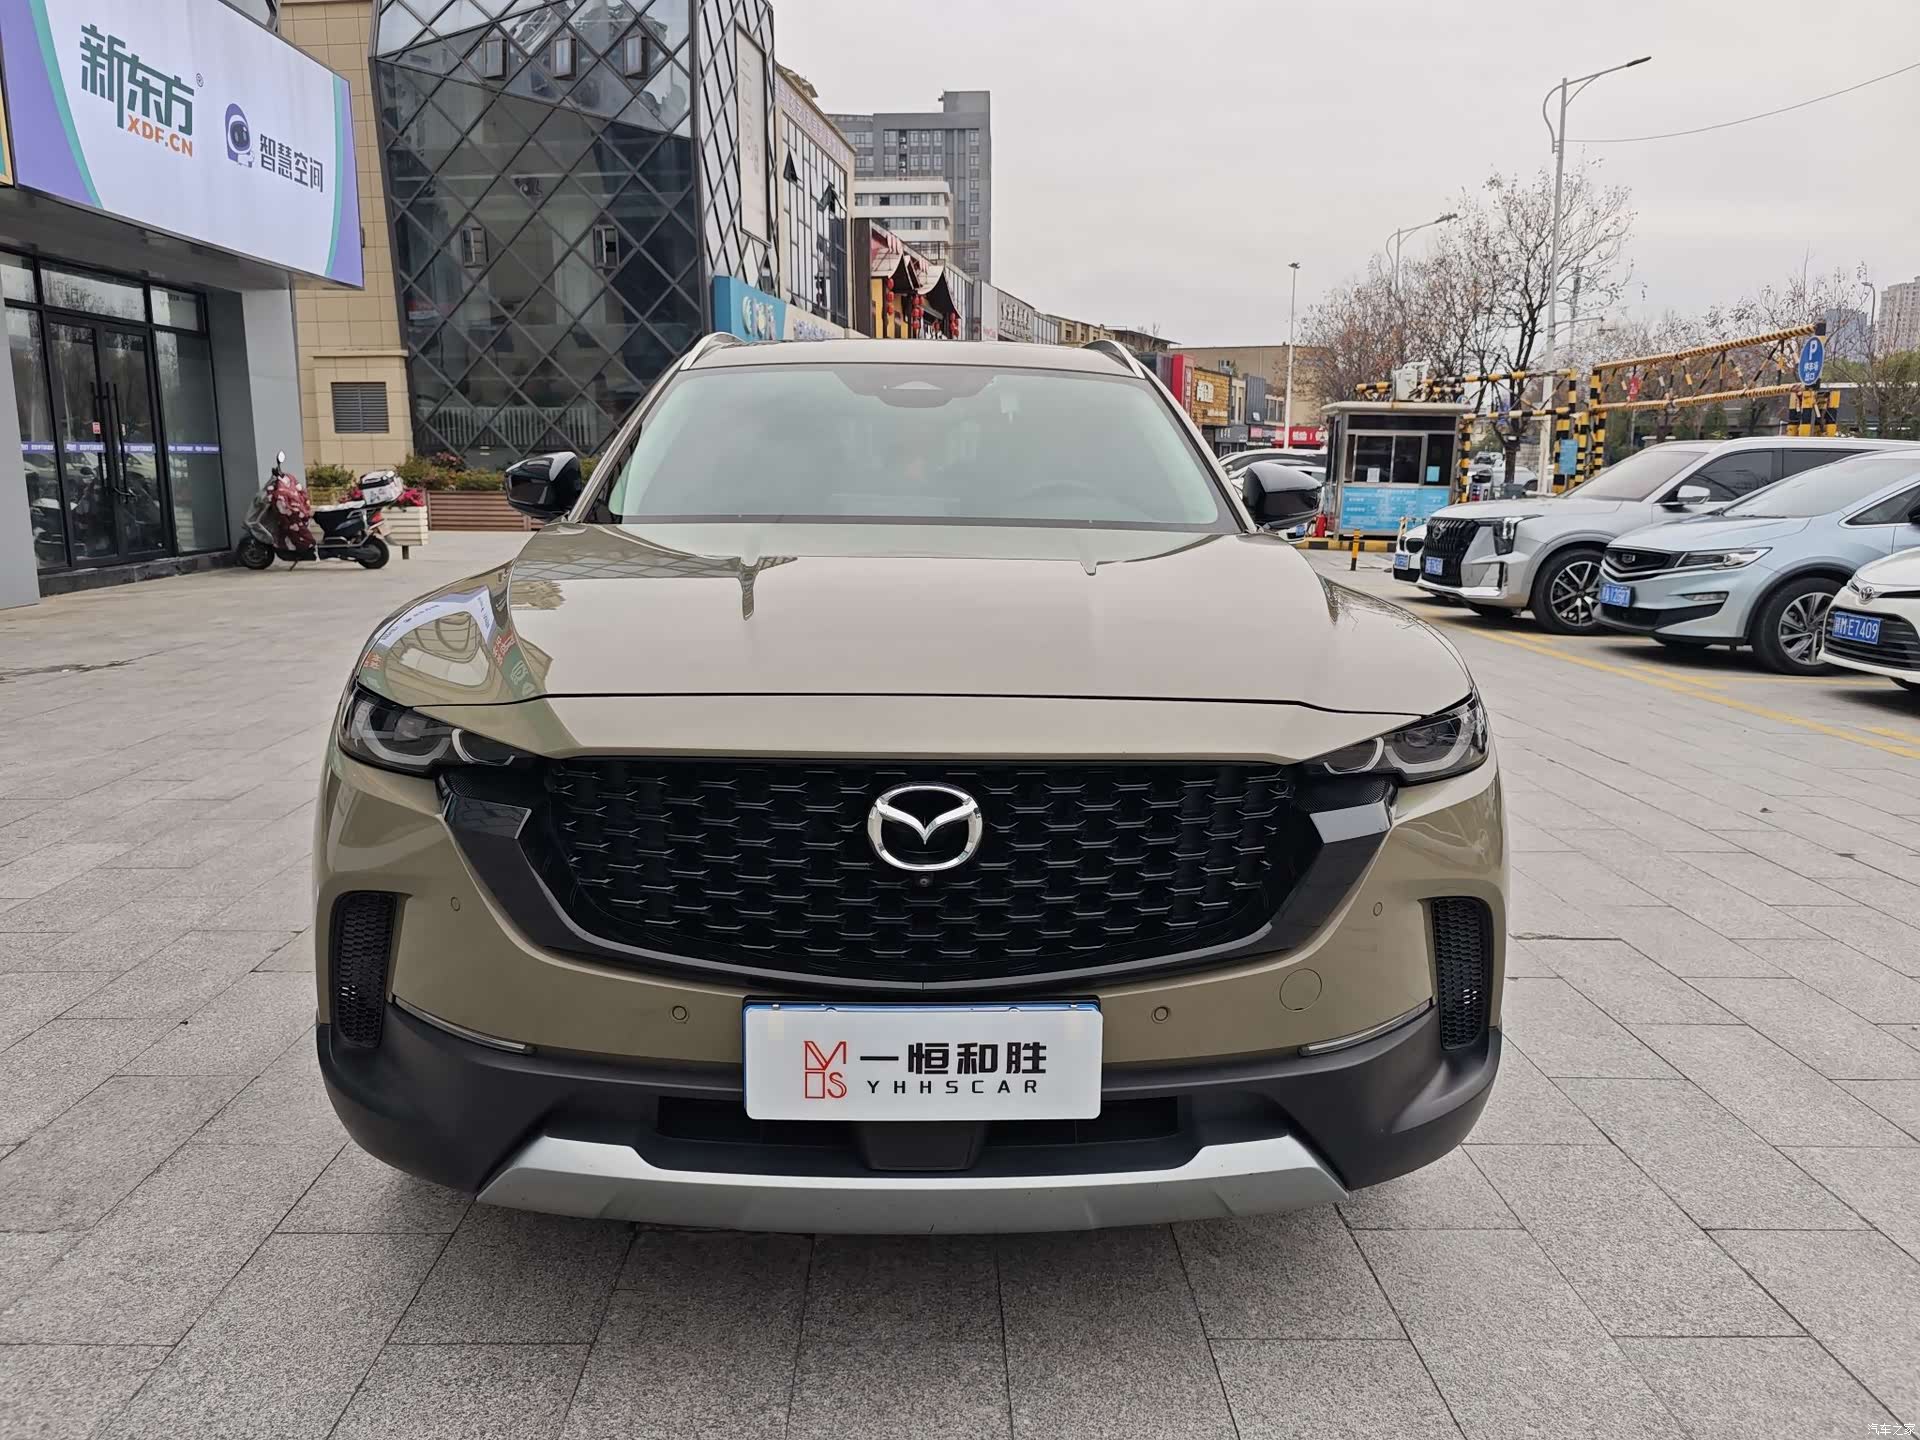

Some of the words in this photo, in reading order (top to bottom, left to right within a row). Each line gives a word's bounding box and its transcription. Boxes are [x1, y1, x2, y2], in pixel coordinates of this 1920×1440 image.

[79, 23, 195, 137] 新东方
[127, 113, 194, 158] XDF.CN
[259, 133, 324, 193] 智慧空间
[1808, 339, 1818, 361] P
[859, 1041, 1048, 1075] 一恒和胜
